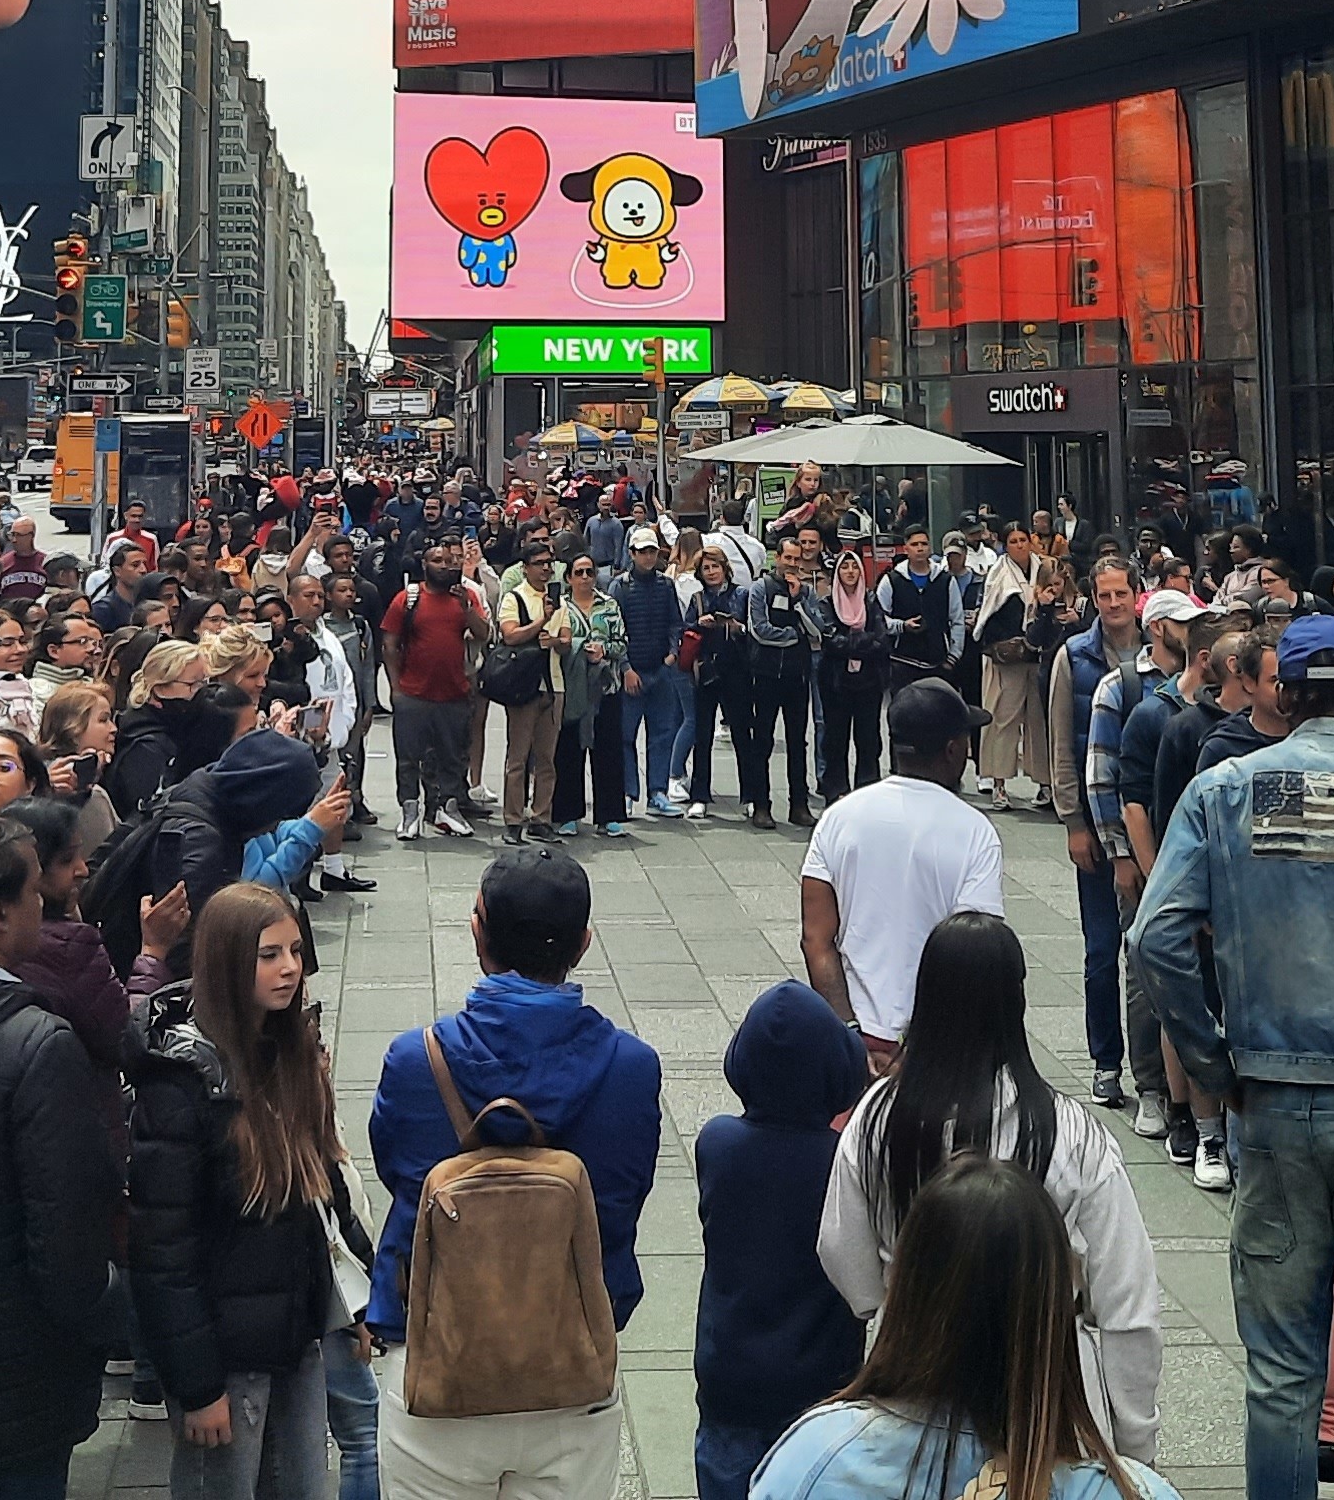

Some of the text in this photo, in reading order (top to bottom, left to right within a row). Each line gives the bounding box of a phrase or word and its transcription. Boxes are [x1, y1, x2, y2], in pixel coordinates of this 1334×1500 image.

[409, 10, 440, 26] The
[407, 26, 457, 42] Music
[88, 161, 126, 176] ONLY
[543, 337, 614, 362] NEW
[78, 380, 125, 389] ONE WAY
[190, 371, 217, 388] 25
[988, 382, 1055, 413] swatch
